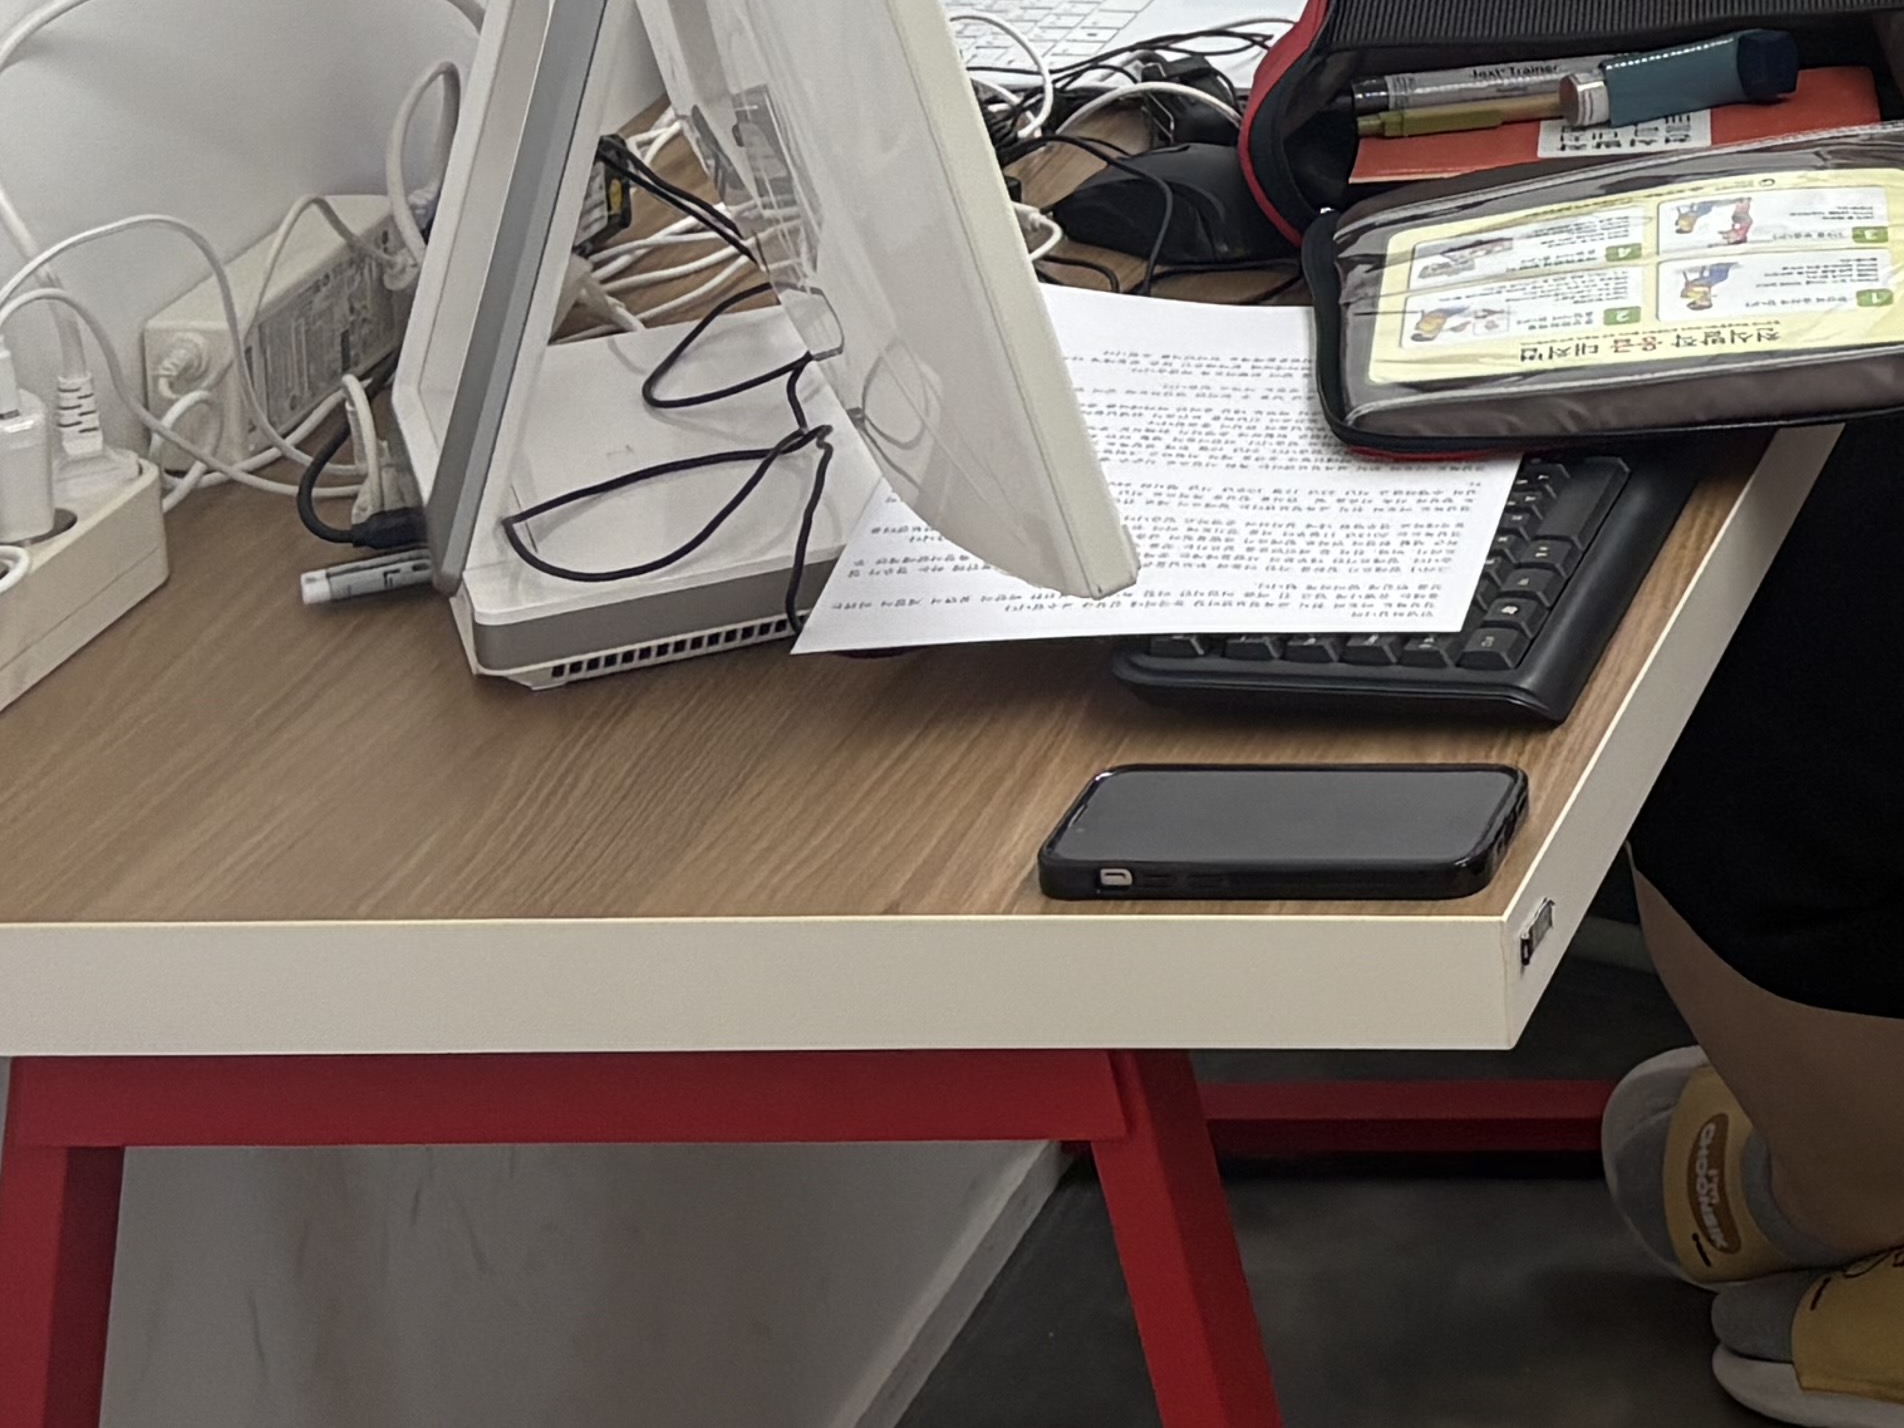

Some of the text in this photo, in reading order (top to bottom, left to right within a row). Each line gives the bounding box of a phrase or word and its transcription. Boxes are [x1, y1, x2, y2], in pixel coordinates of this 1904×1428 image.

[1615, 310, 1630, 322] 2
[1609, 335, 1663, 354] 응급
[1671, 327, 1782, 349] 천식발작
[1695, 1122, 1729, 1249] CHOONSIK
